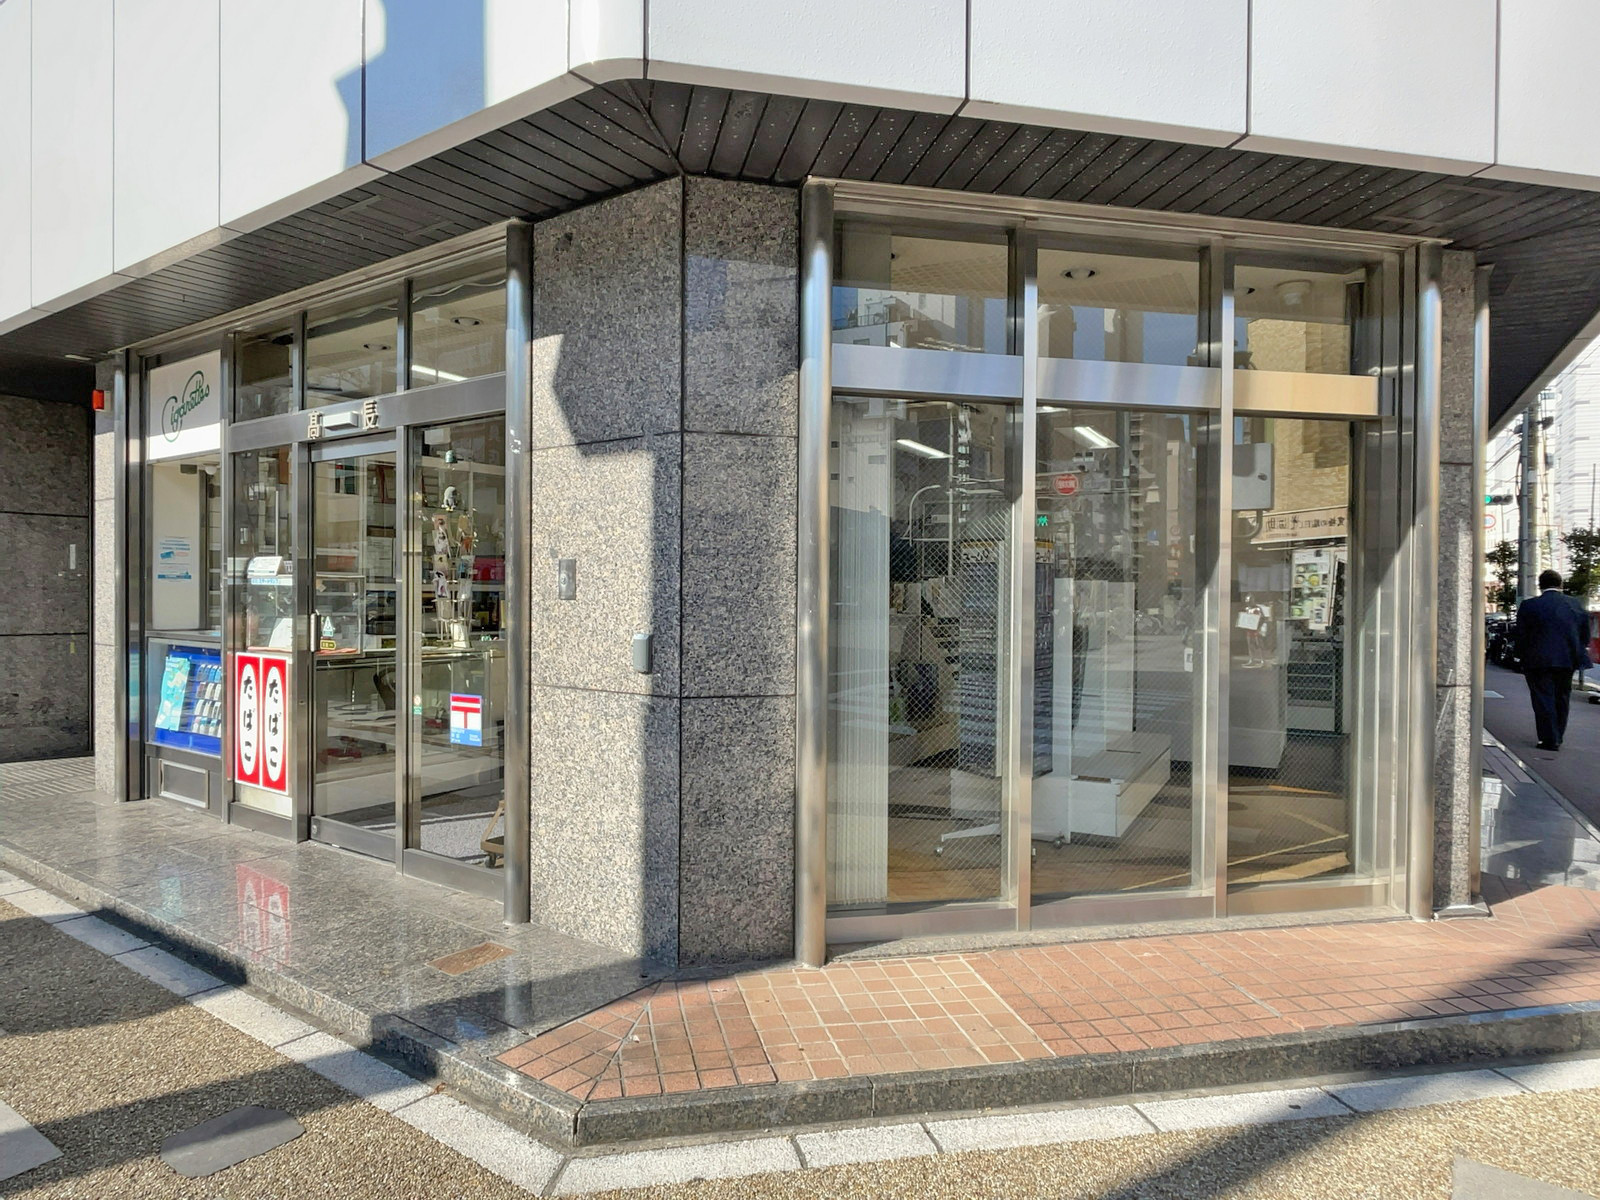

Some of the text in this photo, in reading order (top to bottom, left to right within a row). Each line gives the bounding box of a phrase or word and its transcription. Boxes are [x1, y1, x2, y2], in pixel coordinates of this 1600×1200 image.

[162, 371, 210, 442] Cigarettes
[243, 677, 256, 762] たばこ
[268, 680, 282, 768] たばこ
